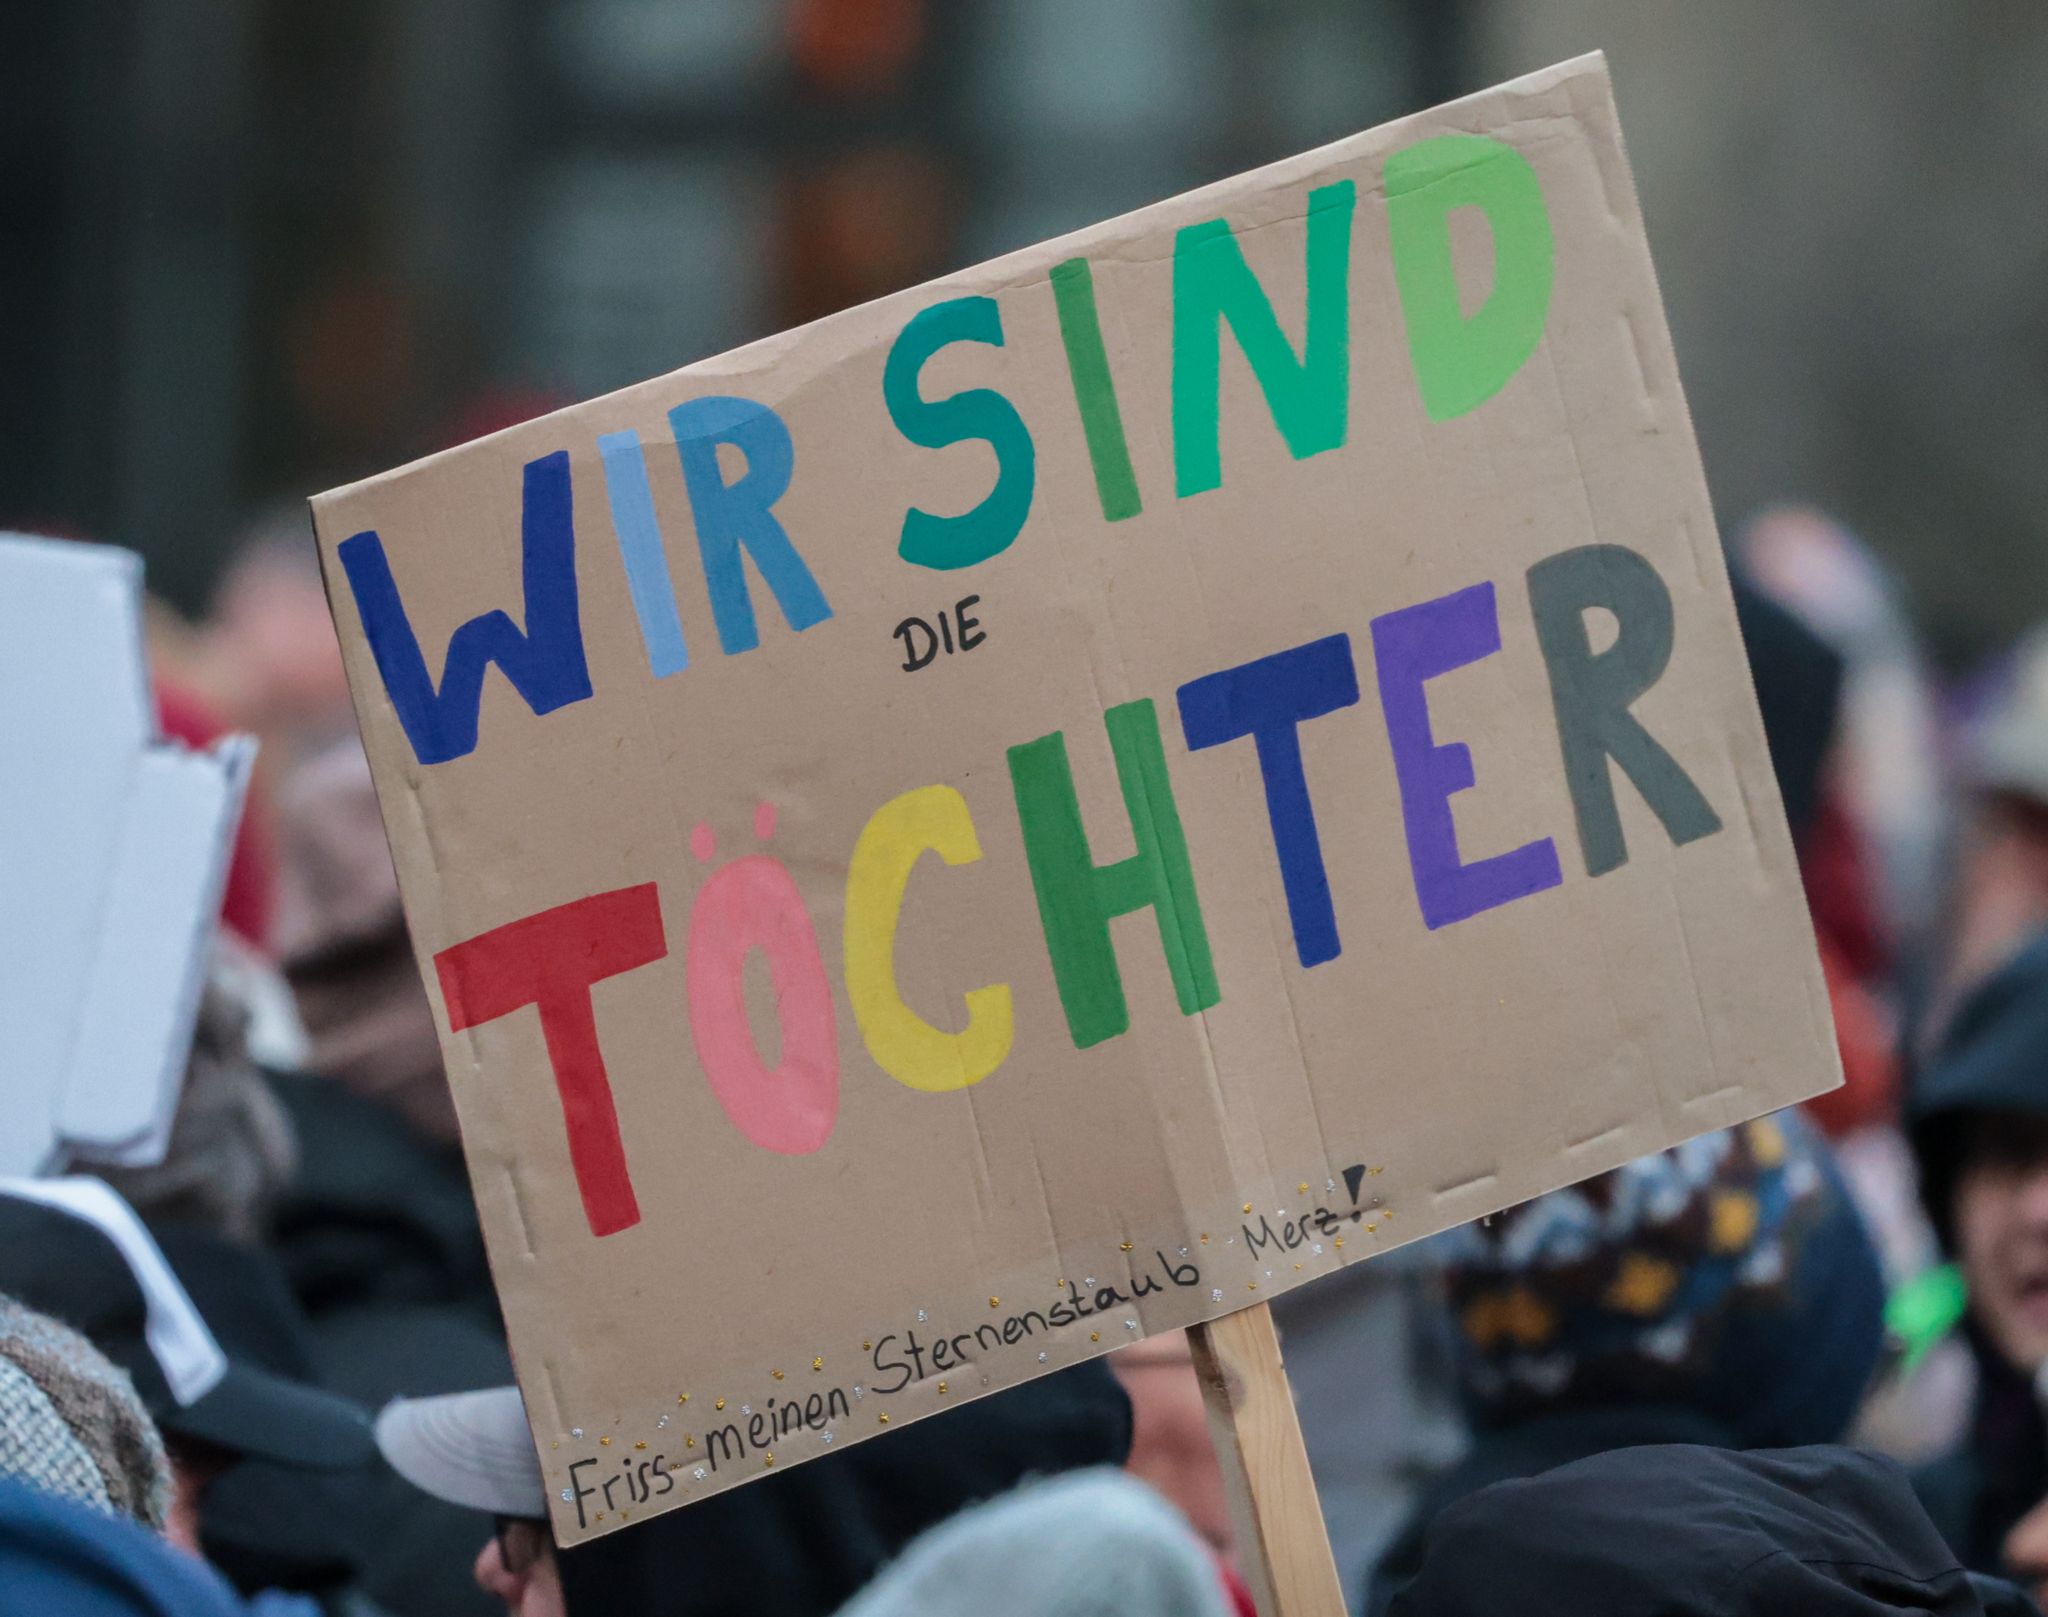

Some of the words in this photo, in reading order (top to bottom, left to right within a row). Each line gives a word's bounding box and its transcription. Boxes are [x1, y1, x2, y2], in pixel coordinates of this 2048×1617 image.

[338, 396, 832, 764] WIR
[884, 131, 1555, 570] SIND
[893, 594, 987, 672] DIE
[435, 544, 1722, 1236] TÖCHTER
[569, 1453, 674, 1528] Friss
[706, 1386, 851, 1472] meinen
[872, 1251, 1200, 1394] Sternenstaub
[1243, 1164, 1367, 1260] Merz!
